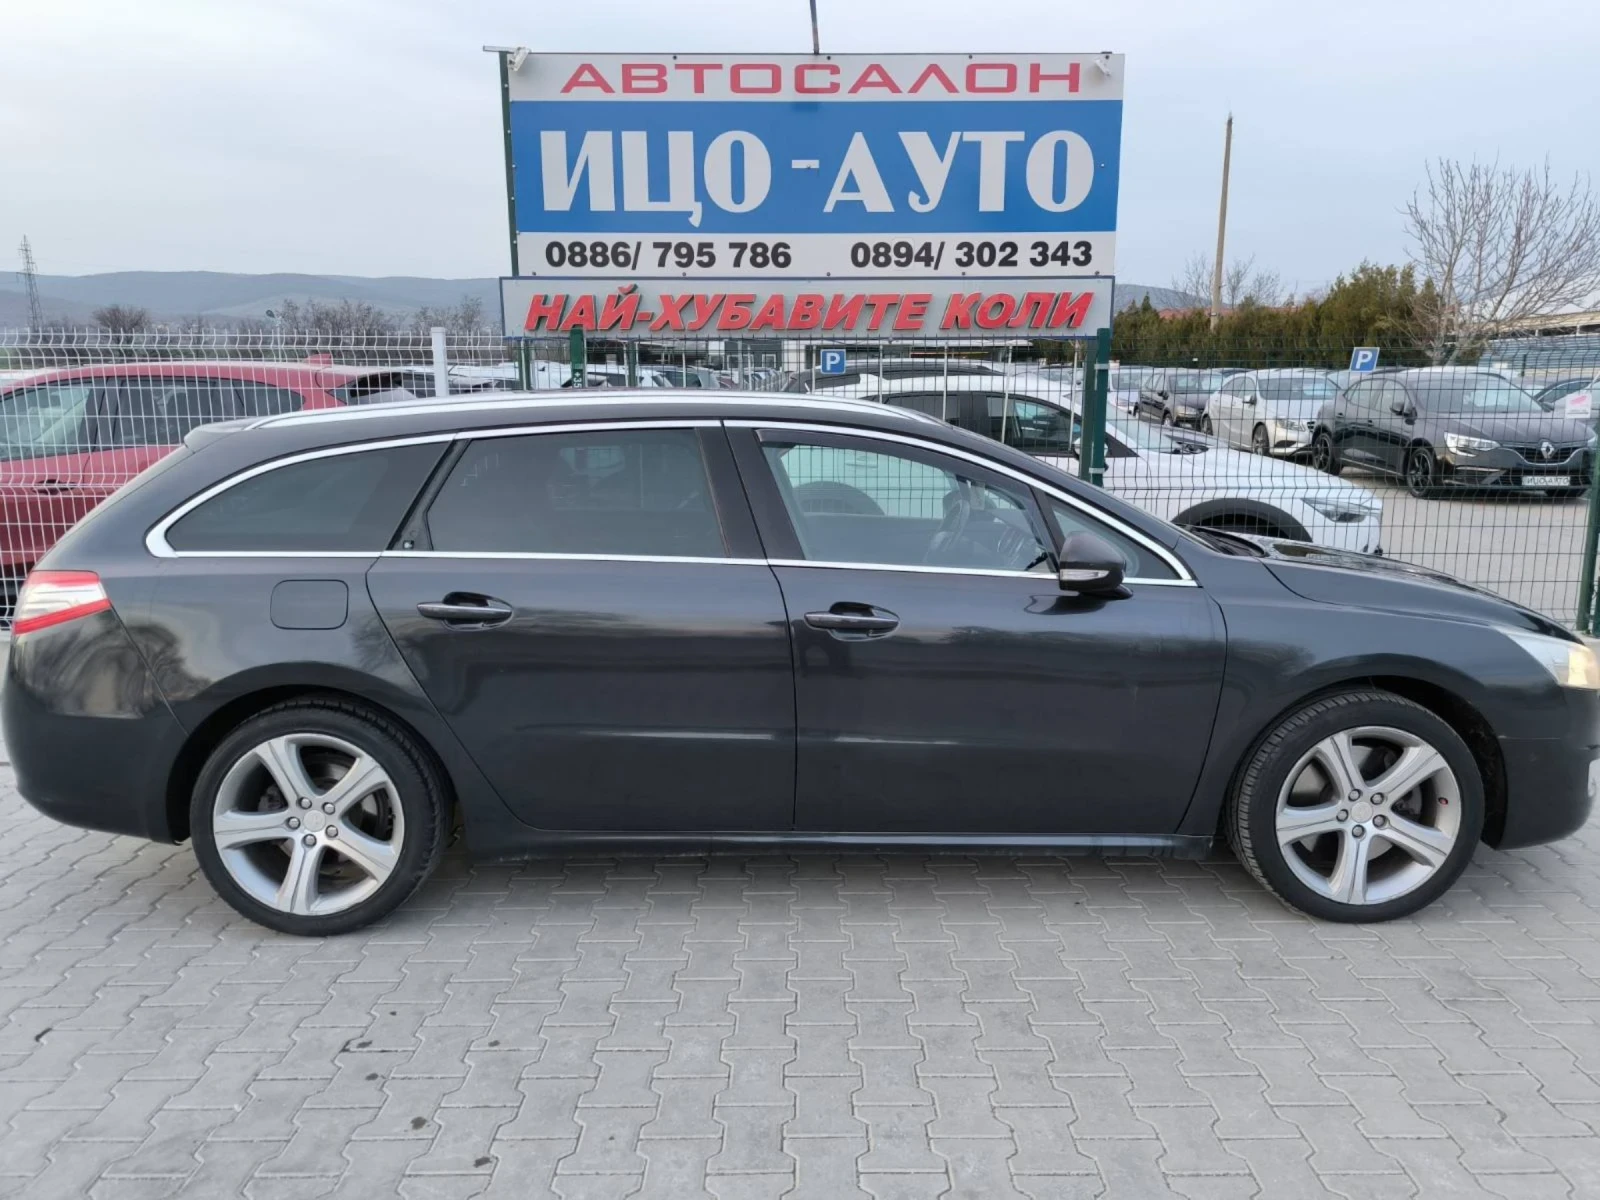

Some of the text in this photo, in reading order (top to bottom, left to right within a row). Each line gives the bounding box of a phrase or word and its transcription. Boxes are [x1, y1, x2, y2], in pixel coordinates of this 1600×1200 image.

[560, 62, 1081, 94] АВТОСАЛОН
[545, 241, 792, 270] 0886/ 795 786
[850, 240, 1093, 270] 0894/ 302 343
[523, 283, 1095, 332] НАЙ-ХУБАВИТЕ КОЛИ
[826, 352, 841, 371] P
[1355, 350, 1373, 370] P
